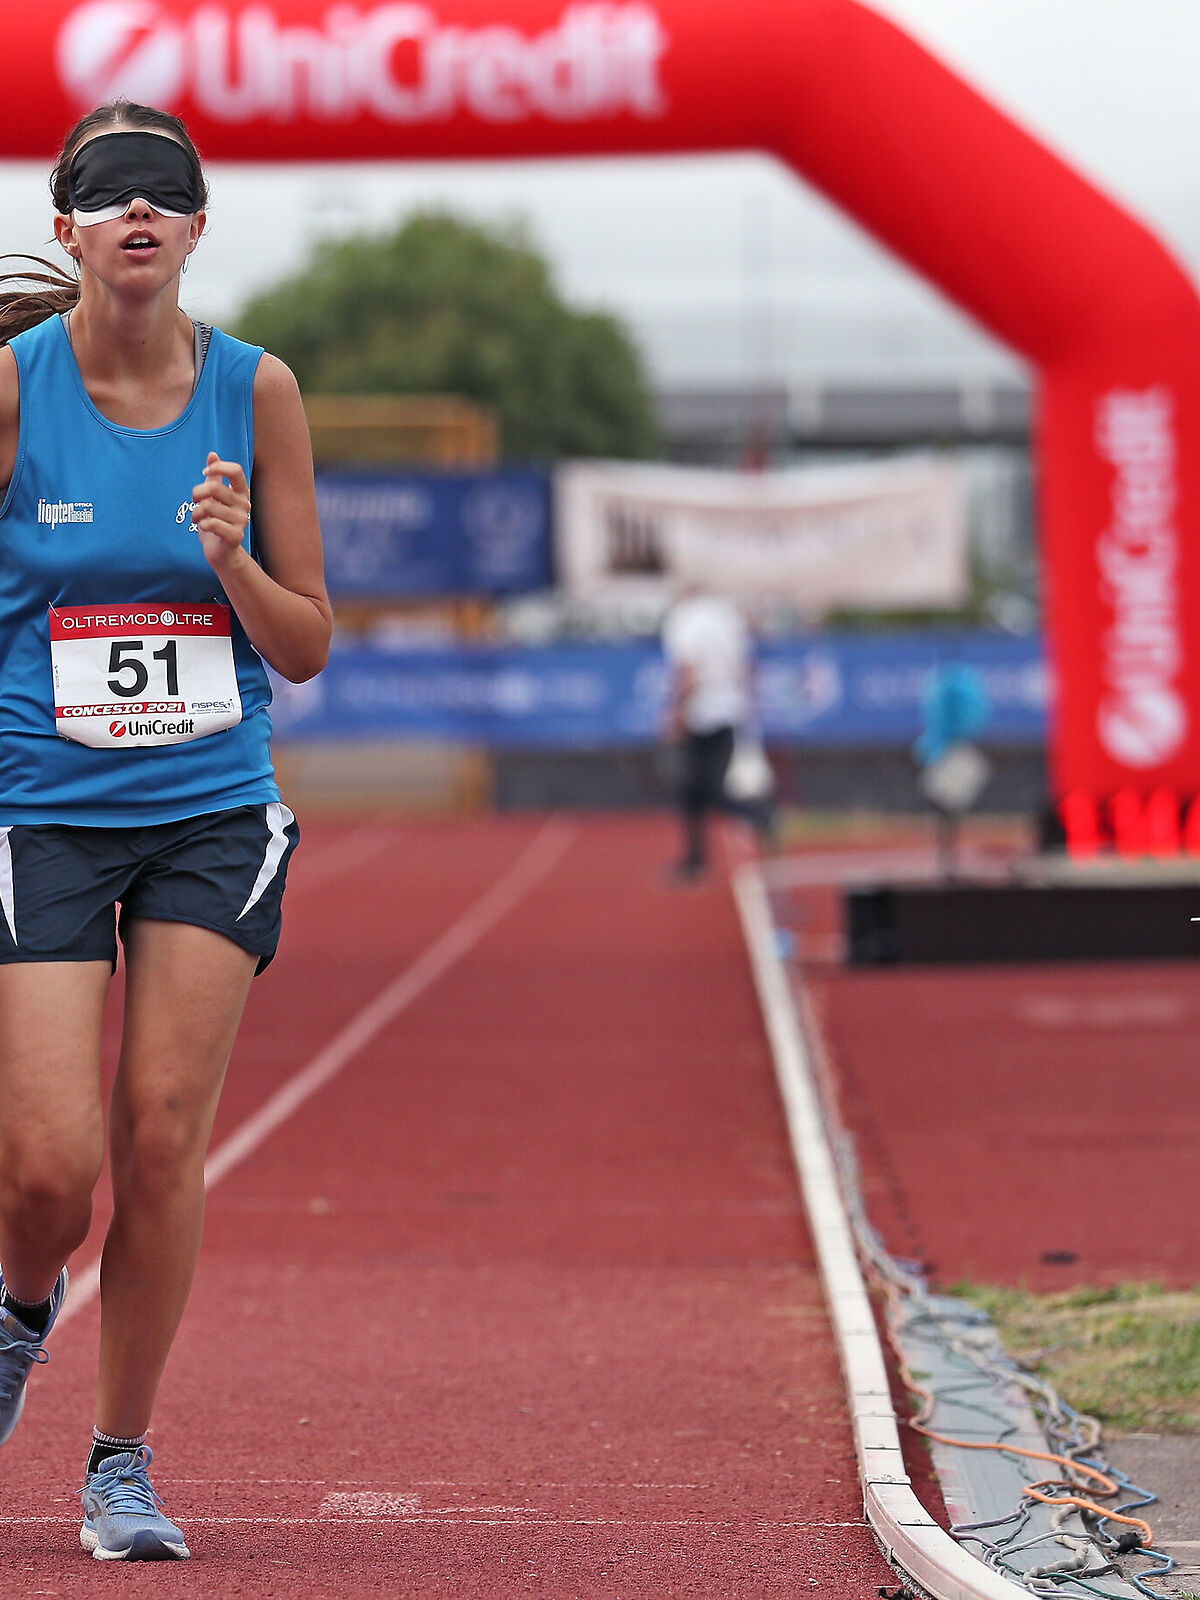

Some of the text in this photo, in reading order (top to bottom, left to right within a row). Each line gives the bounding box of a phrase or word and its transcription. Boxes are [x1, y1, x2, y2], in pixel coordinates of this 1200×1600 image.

[193, 2, 667, 123] UniCredit
[107, 640, 179, 698] 51
[62, 704, 143, 717] CONCESIO
[146, 702, 182, 712] 2021
[128, 719, 194, 736] UniCredit
